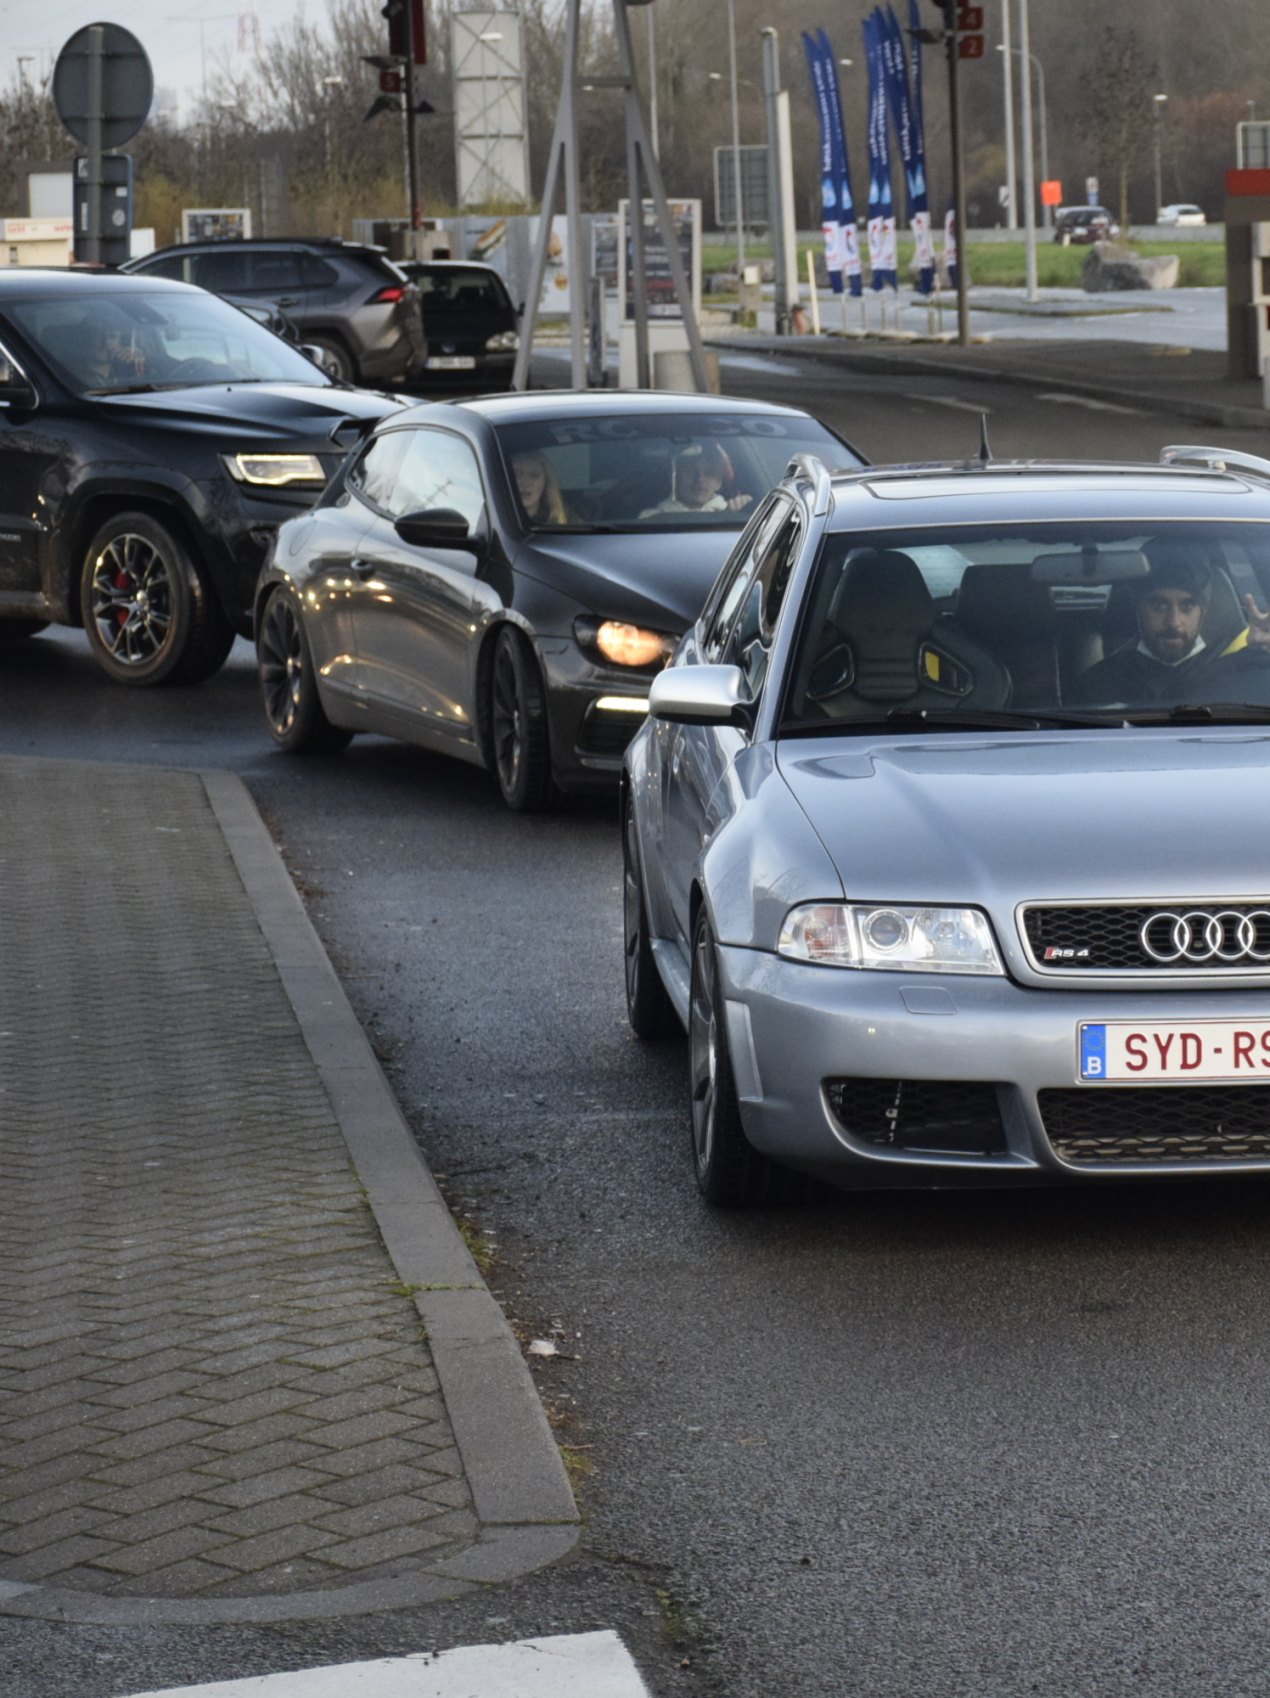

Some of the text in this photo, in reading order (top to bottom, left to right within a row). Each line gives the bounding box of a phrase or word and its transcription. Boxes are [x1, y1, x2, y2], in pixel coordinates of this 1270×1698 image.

[1050, 949, 1089, 957] RS 4
[1087, 1056, 1102, 1075] B
